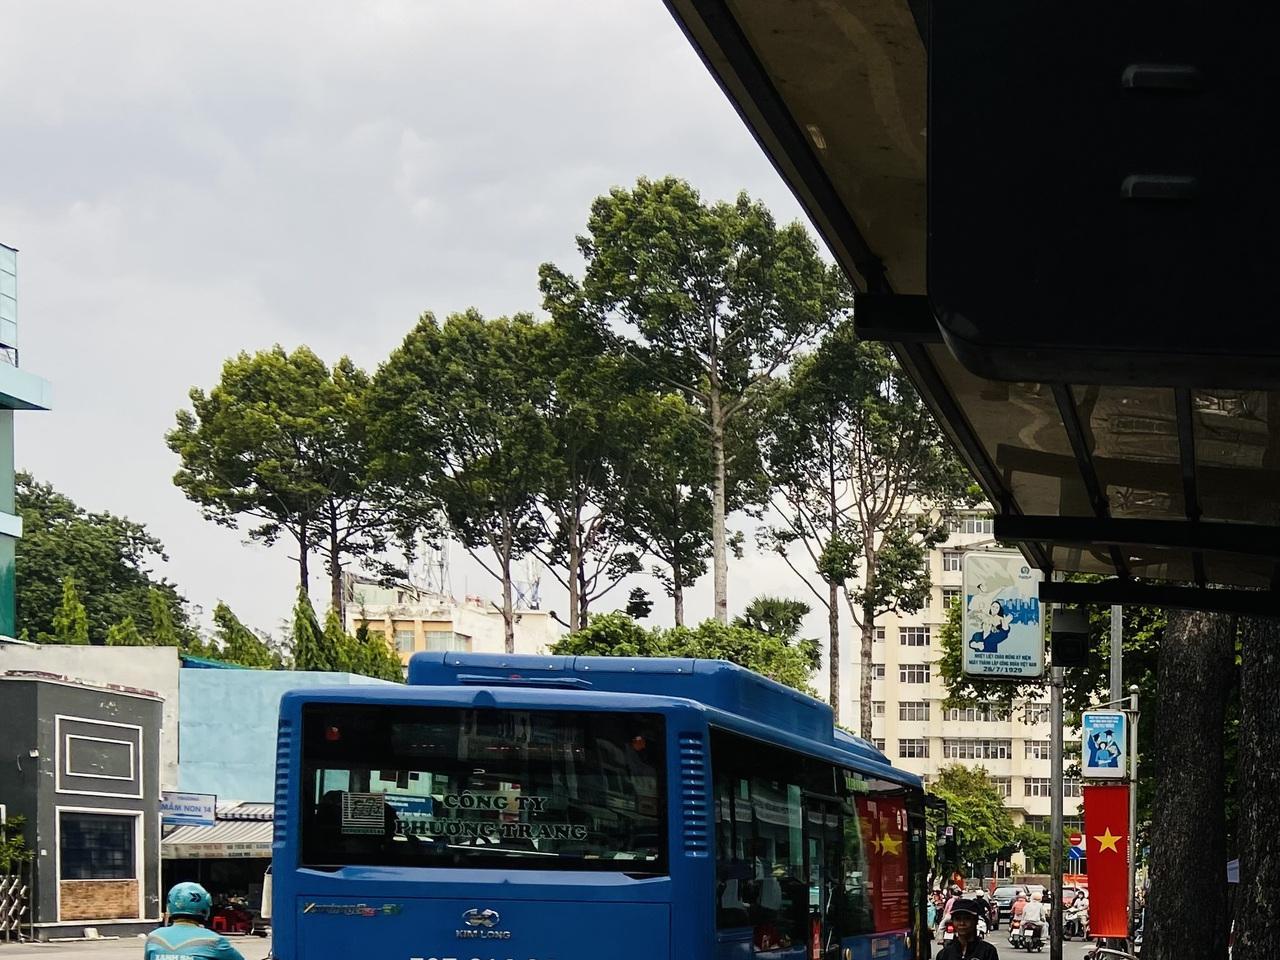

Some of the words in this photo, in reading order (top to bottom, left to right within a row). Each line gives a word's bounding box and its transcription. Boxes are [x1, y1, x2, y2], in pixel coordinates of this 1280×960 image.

[443, 789, 509, 810] CÔNG
[183, 804, 201, 812] NON
[394, 816, 498, 838] PHƯƠNG
[500, 822, 588, 841] TRANG
[455, 929, 478, 939] KIM
[480, 930, 511, 940] LONG
